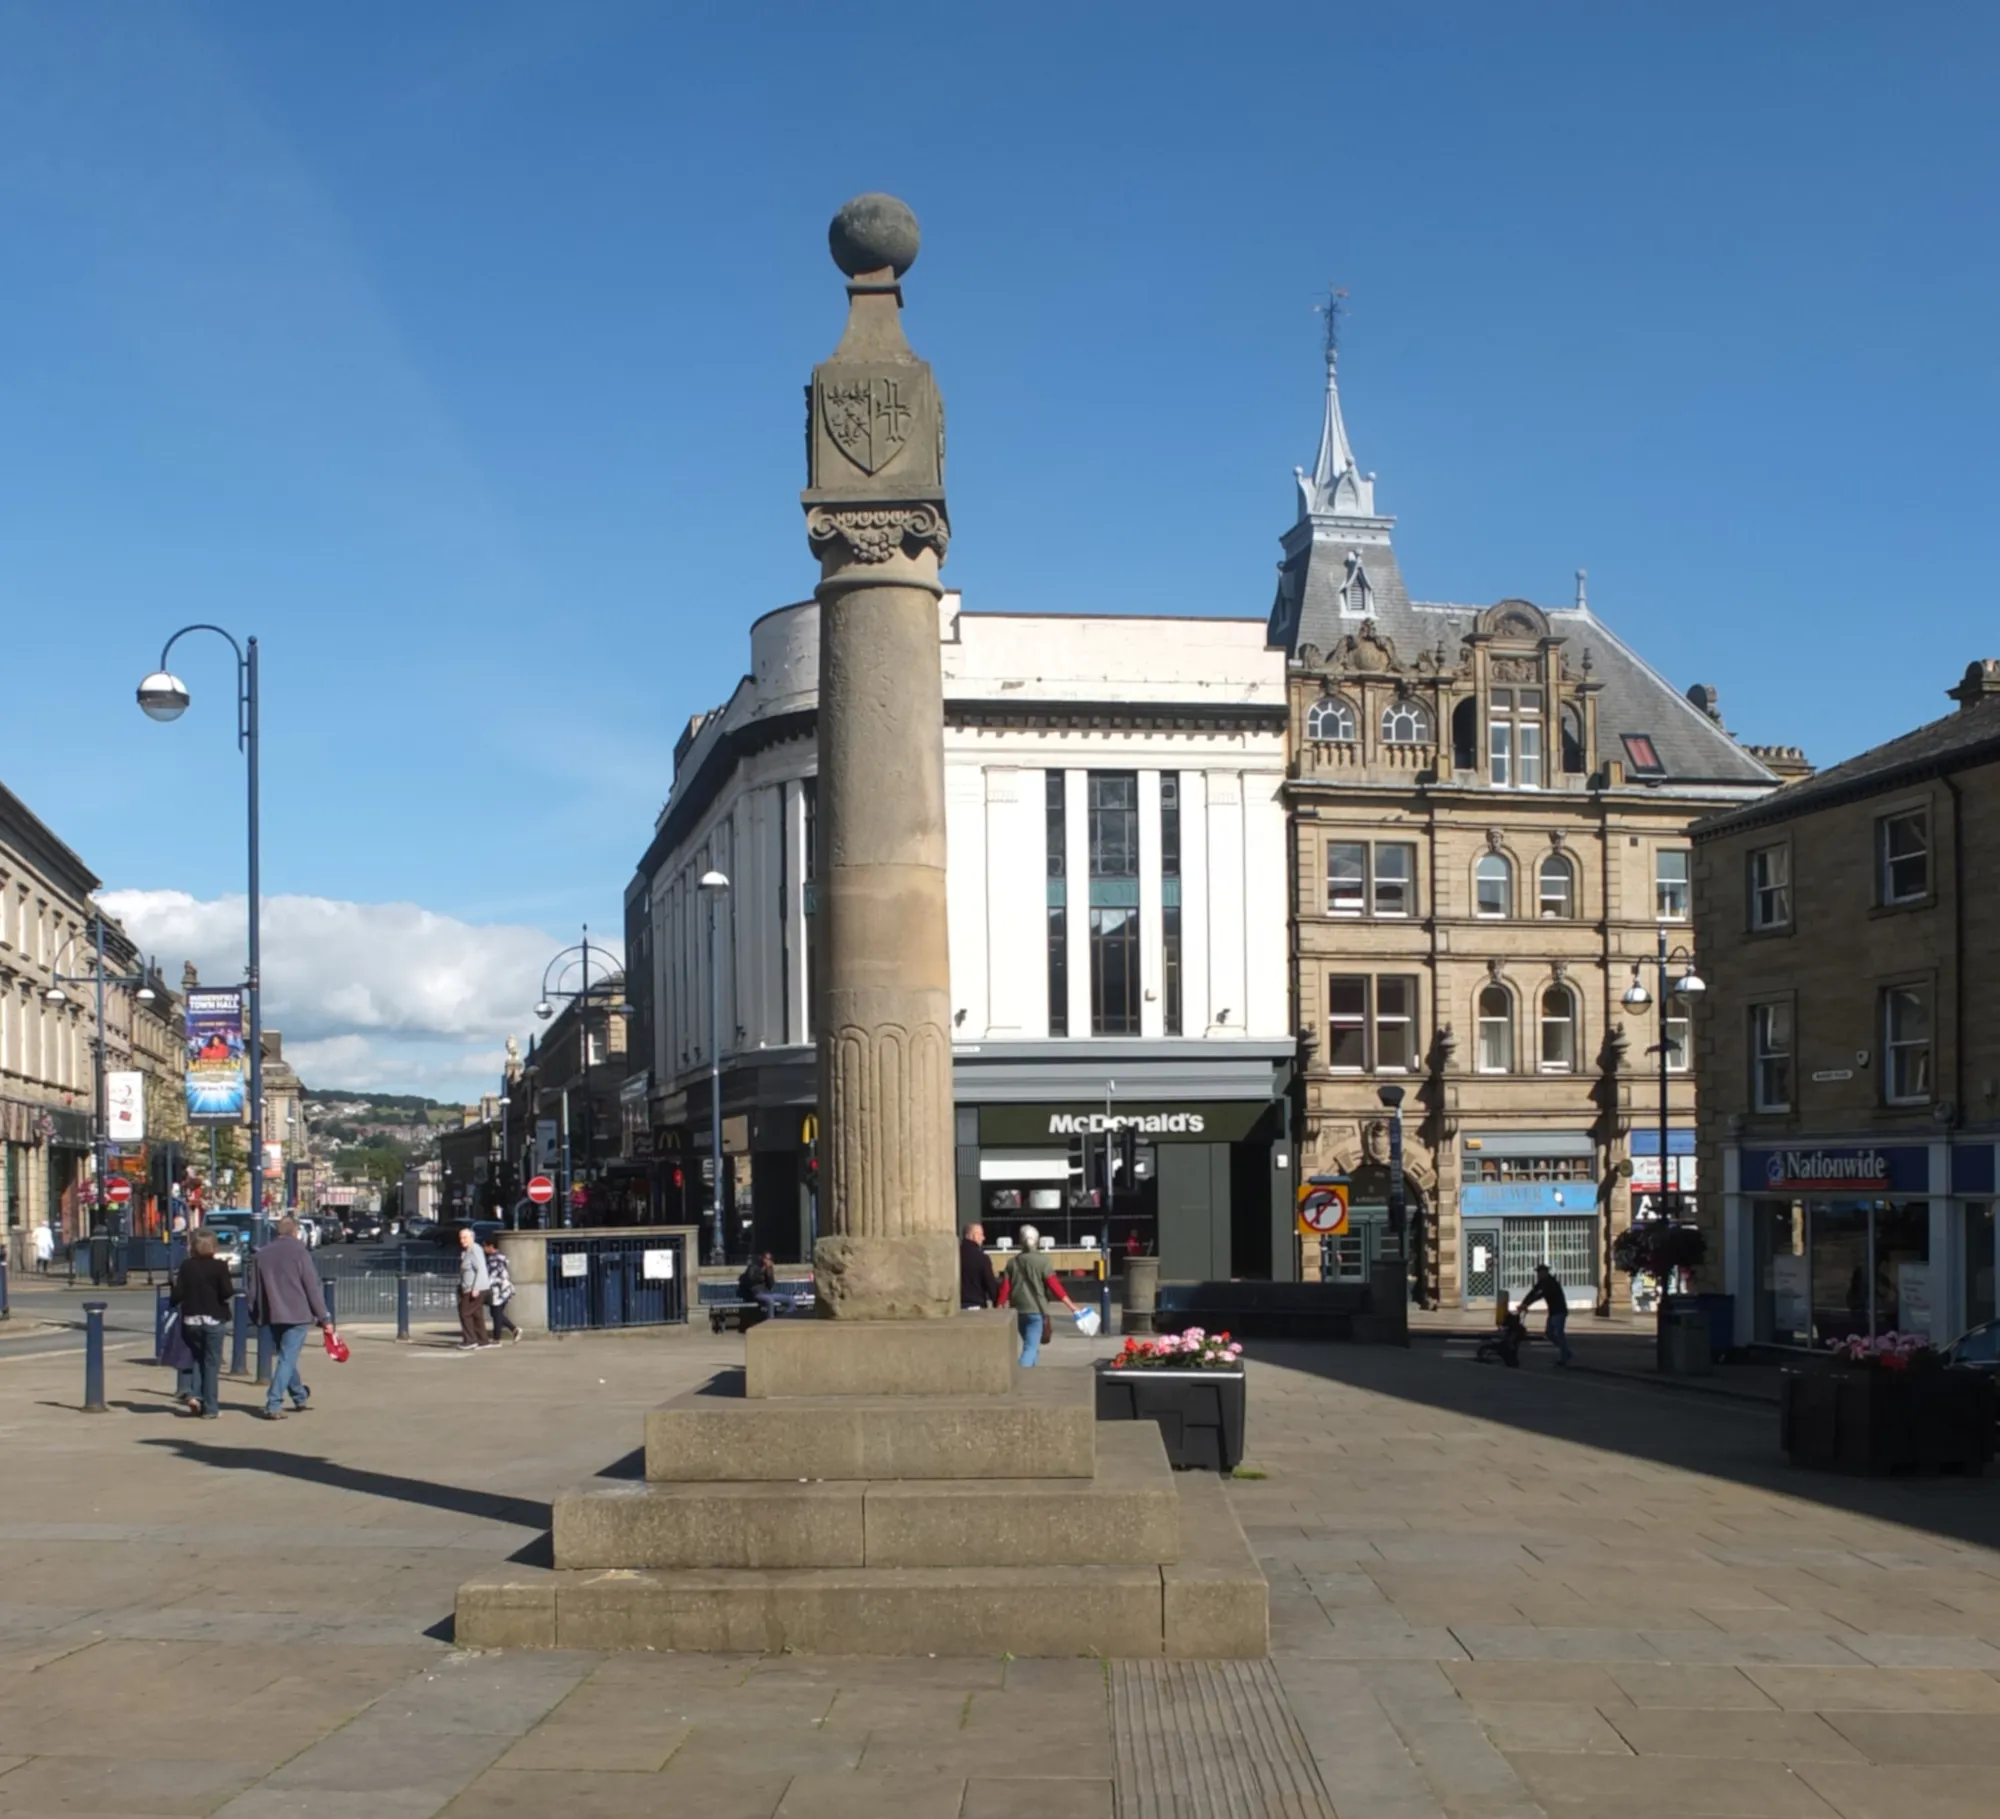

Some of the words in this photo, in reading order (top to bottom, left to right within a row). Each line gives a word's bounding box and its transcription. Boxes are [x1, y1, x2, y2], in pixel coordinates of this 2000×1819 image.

[190, 1001, 215, 1009] TOWN
[216, 1001, 239, 1009] HALL
[1049, 1113, 1204, 1133] McDonald's
[1786, 1150, 1885, 1178] Nationwide
